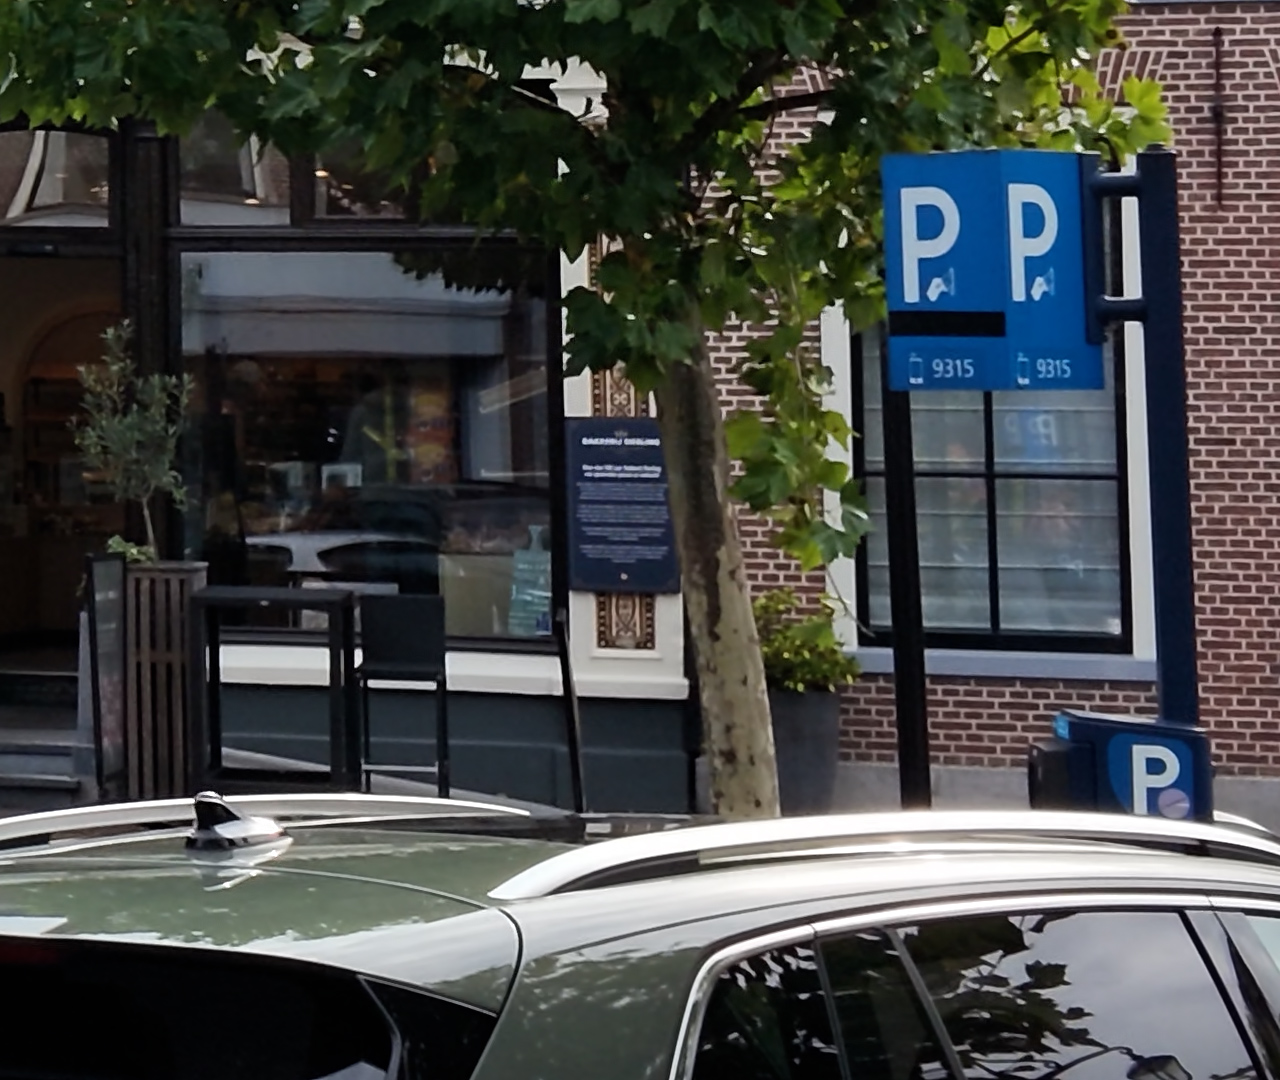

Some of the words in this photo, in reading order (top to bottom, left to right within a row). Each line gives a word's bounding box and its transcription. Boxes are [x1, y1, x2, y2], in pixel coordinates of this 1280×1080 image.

[900, 186, 961, 303] P
[1007, 183, 1059, 302] P
[932, 358, 975, 379] 9315
[1035, 358, 1071, 379] 9315
[1131, 744, 1181, 816] P
